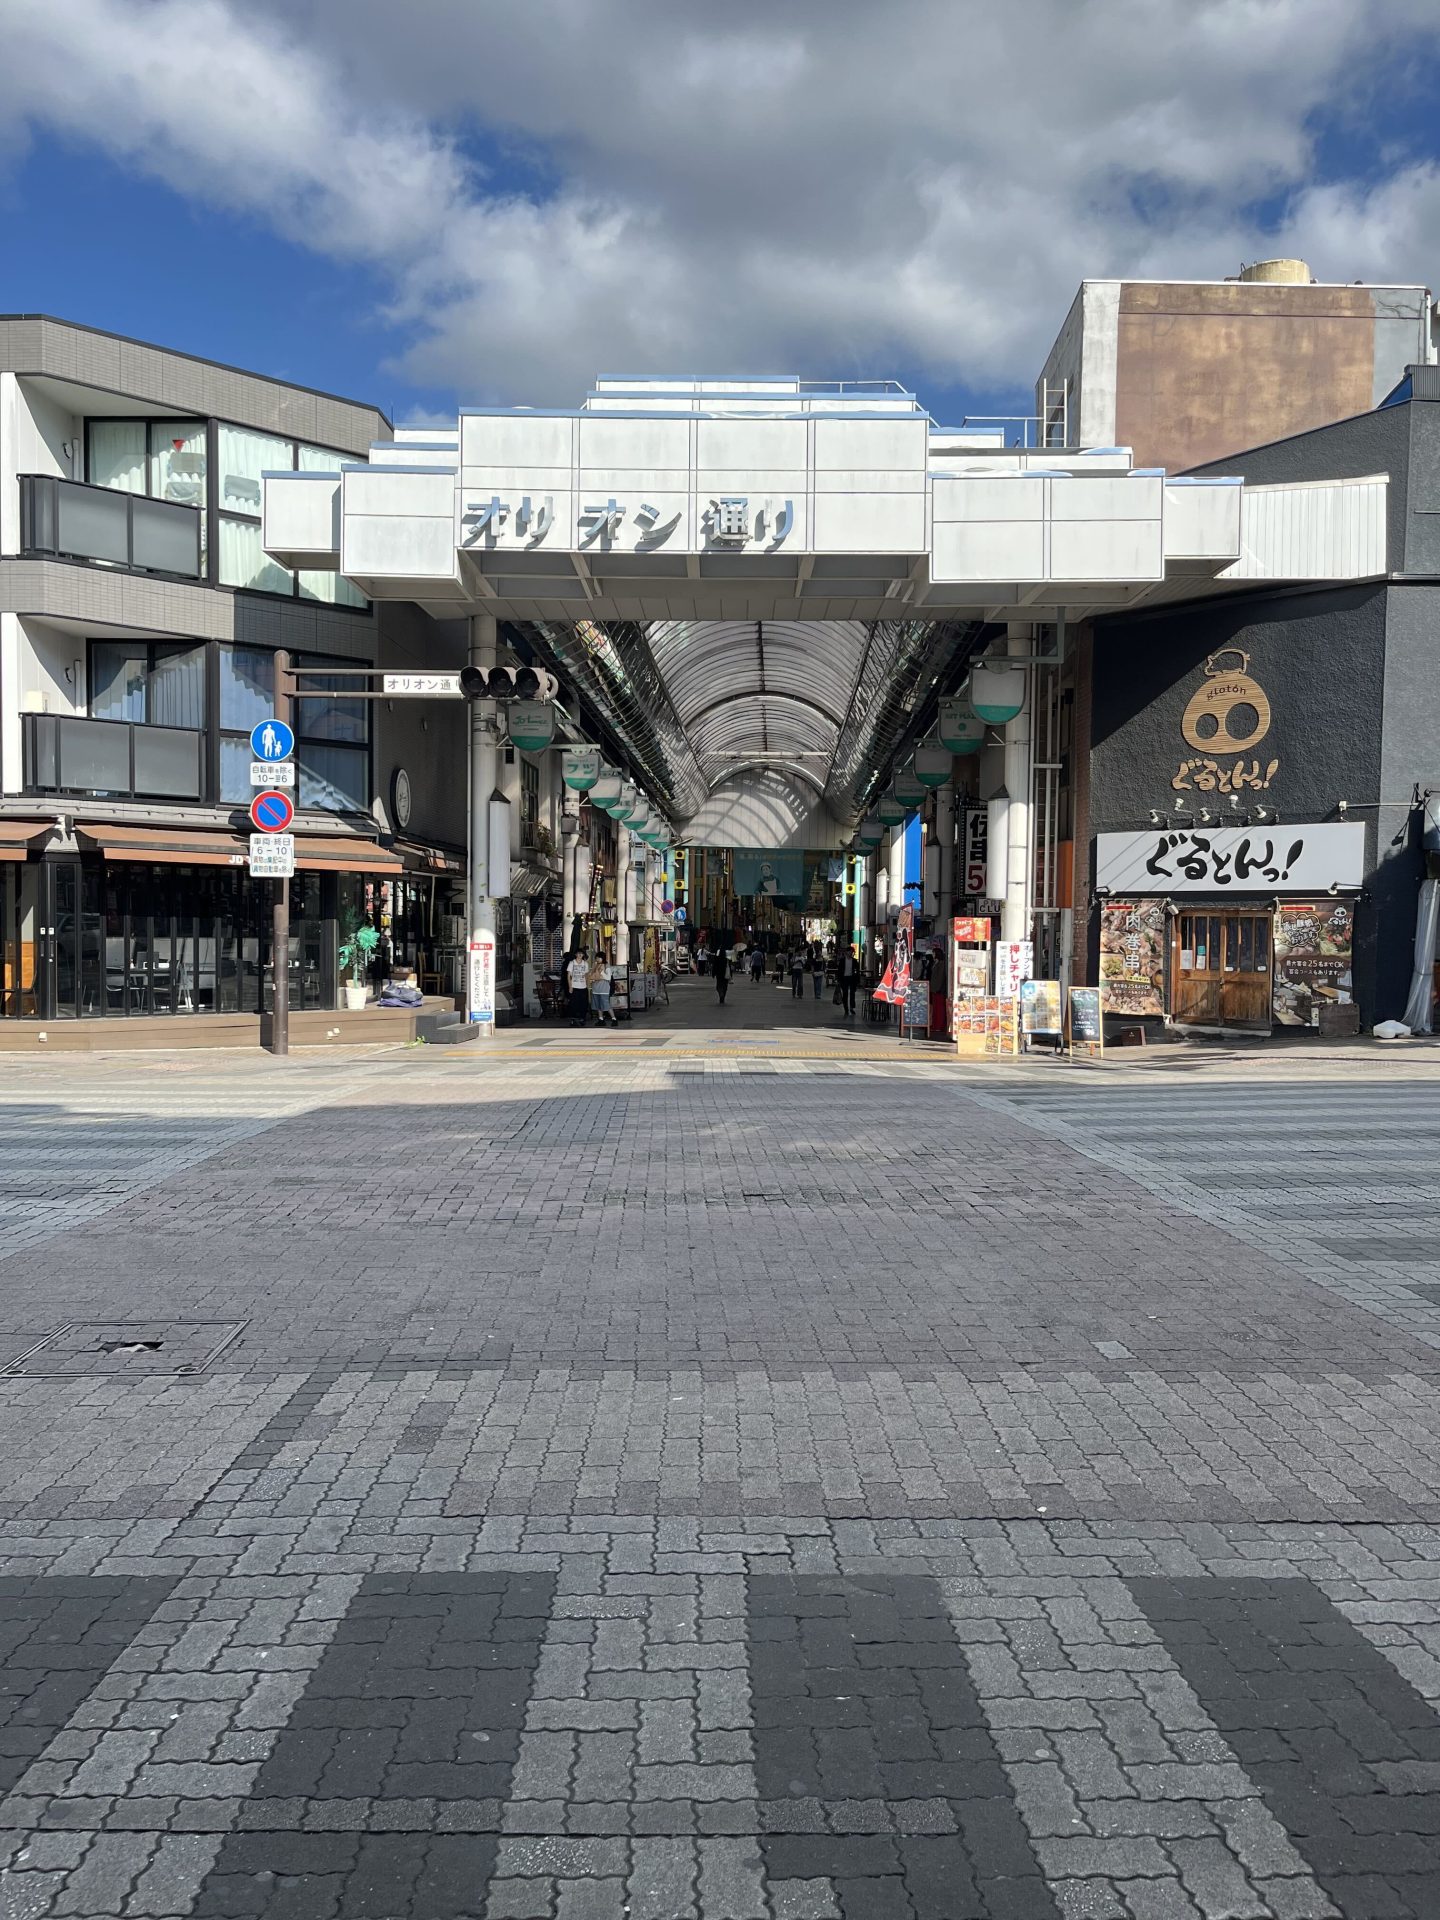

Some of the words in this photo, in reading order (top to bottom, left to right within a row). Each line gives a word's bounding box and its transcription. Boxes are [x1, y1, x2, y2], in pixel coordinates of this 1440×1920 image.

[467, 496, 793, 541] オリオン通り
[387, 678, 458, 690] オリオン通
[1206, 683, 1247, 701] glotón
[1010, 944, 1020, 992] 押しチャリ
